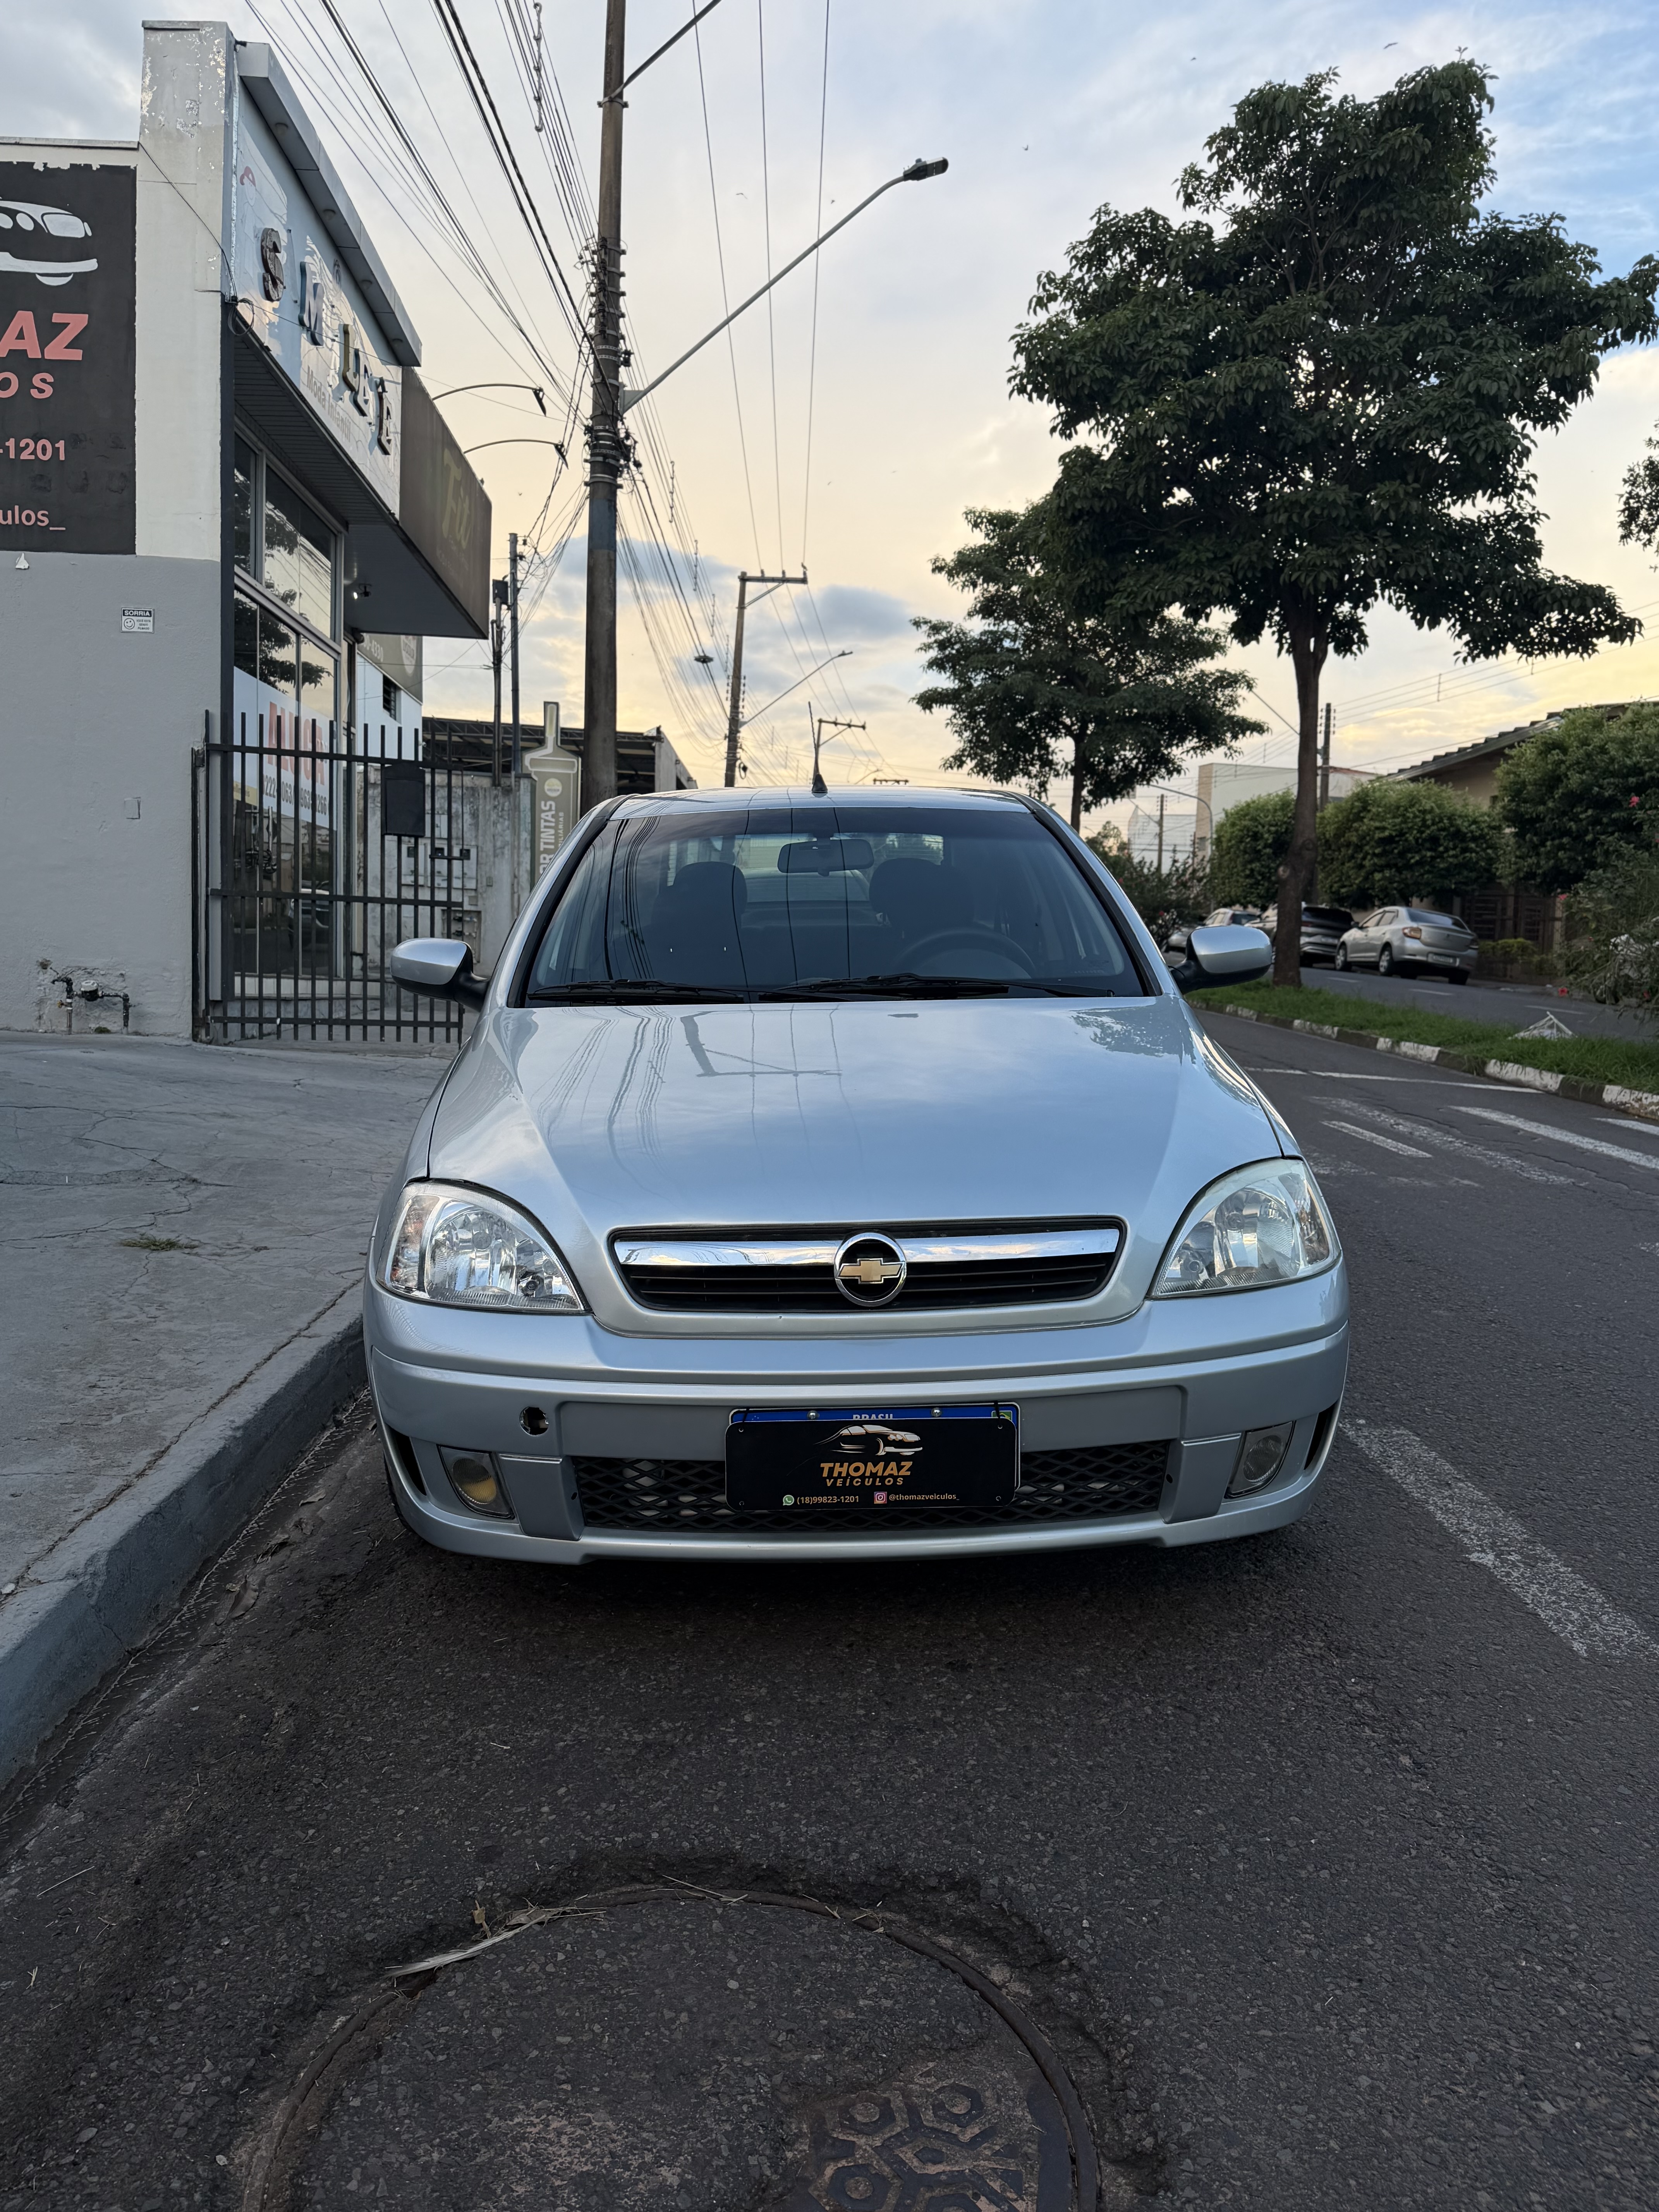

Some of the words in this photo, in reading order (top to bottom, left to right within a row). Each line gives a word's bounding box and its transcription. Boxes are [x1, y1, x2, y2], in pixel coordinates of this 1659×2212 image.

[307, 365, 326, 410] Moda
[540, 800, 555, 851] TINTAS
[820, 1462, 913, 1477] THOMAZ
[826, 1477, 903, 1486] VEÍCULOS
[797, 1496, 859, 1505] (18)99823-1201
